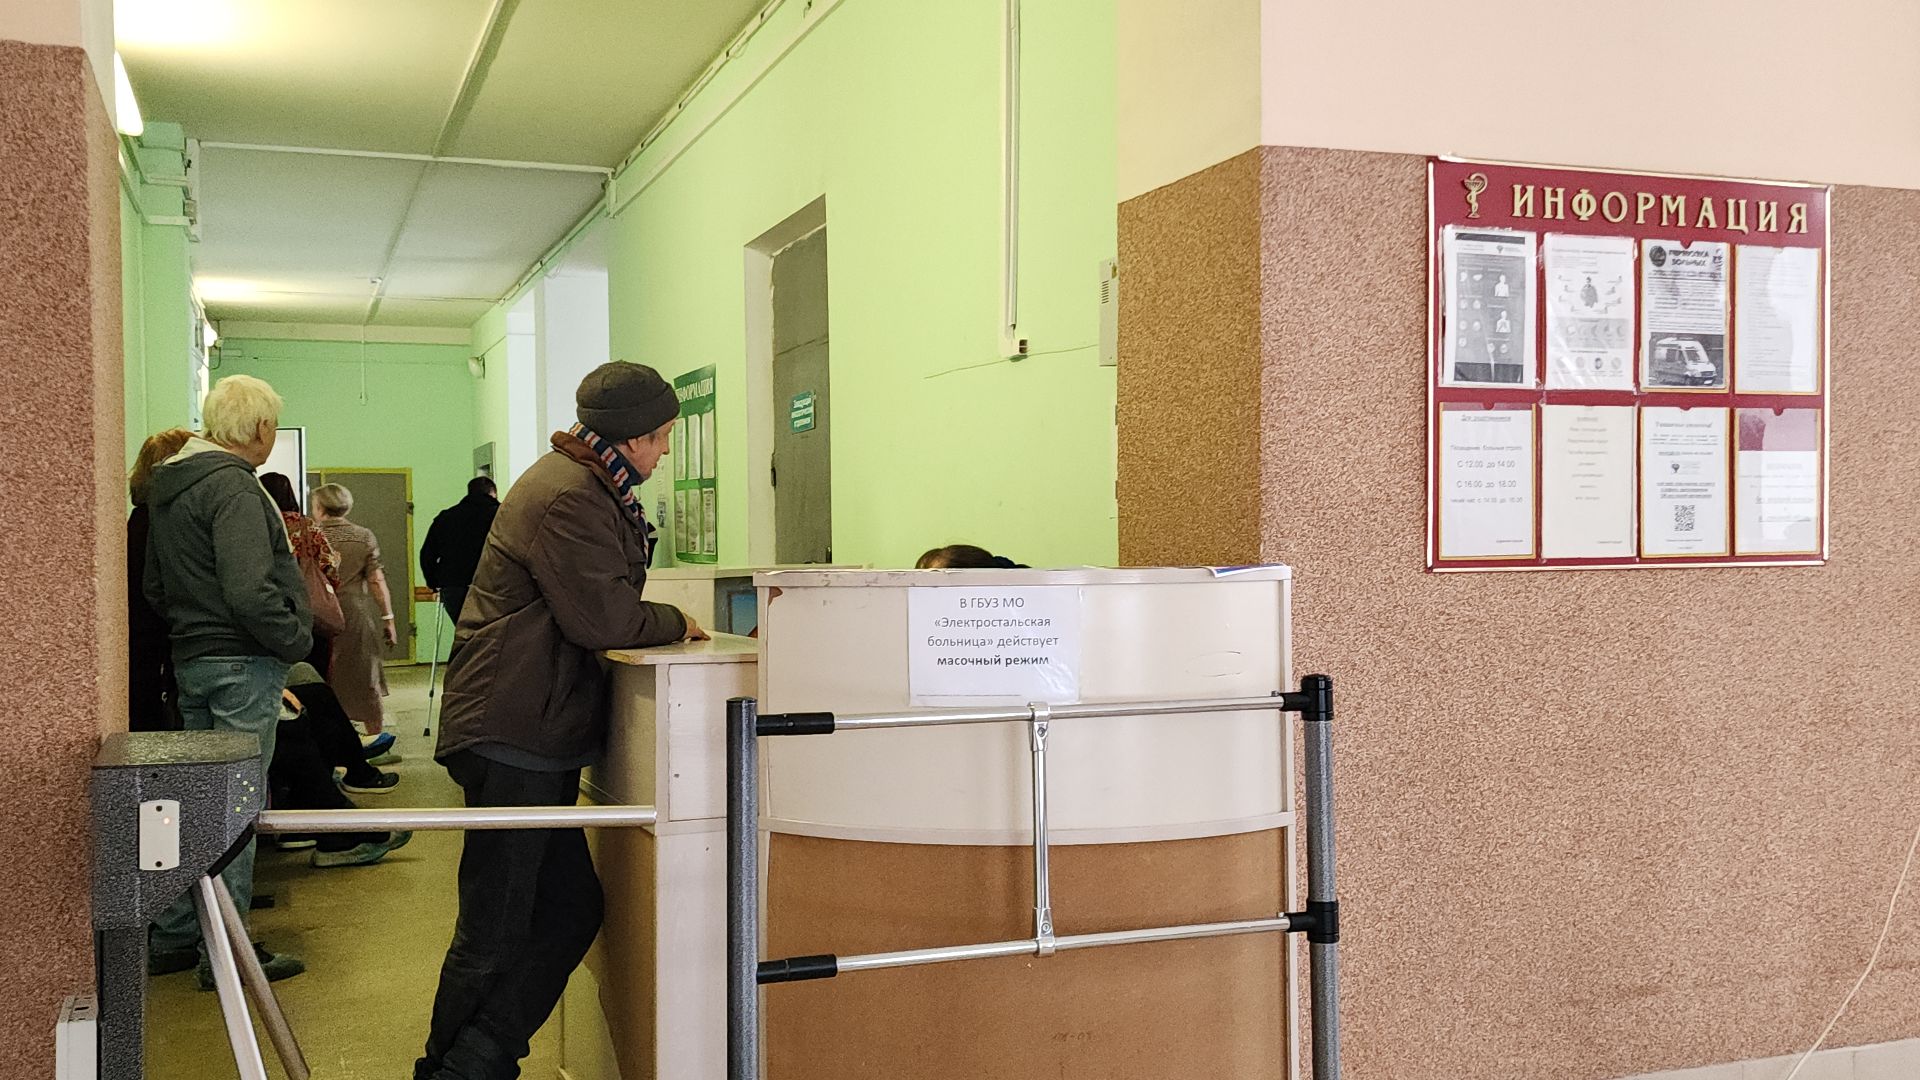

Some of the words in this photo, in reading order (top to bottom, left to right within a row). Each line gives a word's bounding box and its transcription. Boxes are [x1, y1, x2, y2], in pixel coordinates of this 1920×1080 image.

[1512, 184, 1809, 235] ИНФОРМАЦИЯ
[960, 598, 967, 608] В
[971, 598, 999, 608] ГБУЗ
[1002, 597, 1025, 608] МО
[934, 617, 1051, 630] «Электростальская
[927, 636, 993, 648] больница»
[996, 636, 1059, 648] действует
[937, 655, 1001, 666] масочный
[1005, 656, 1049, 667] режим
